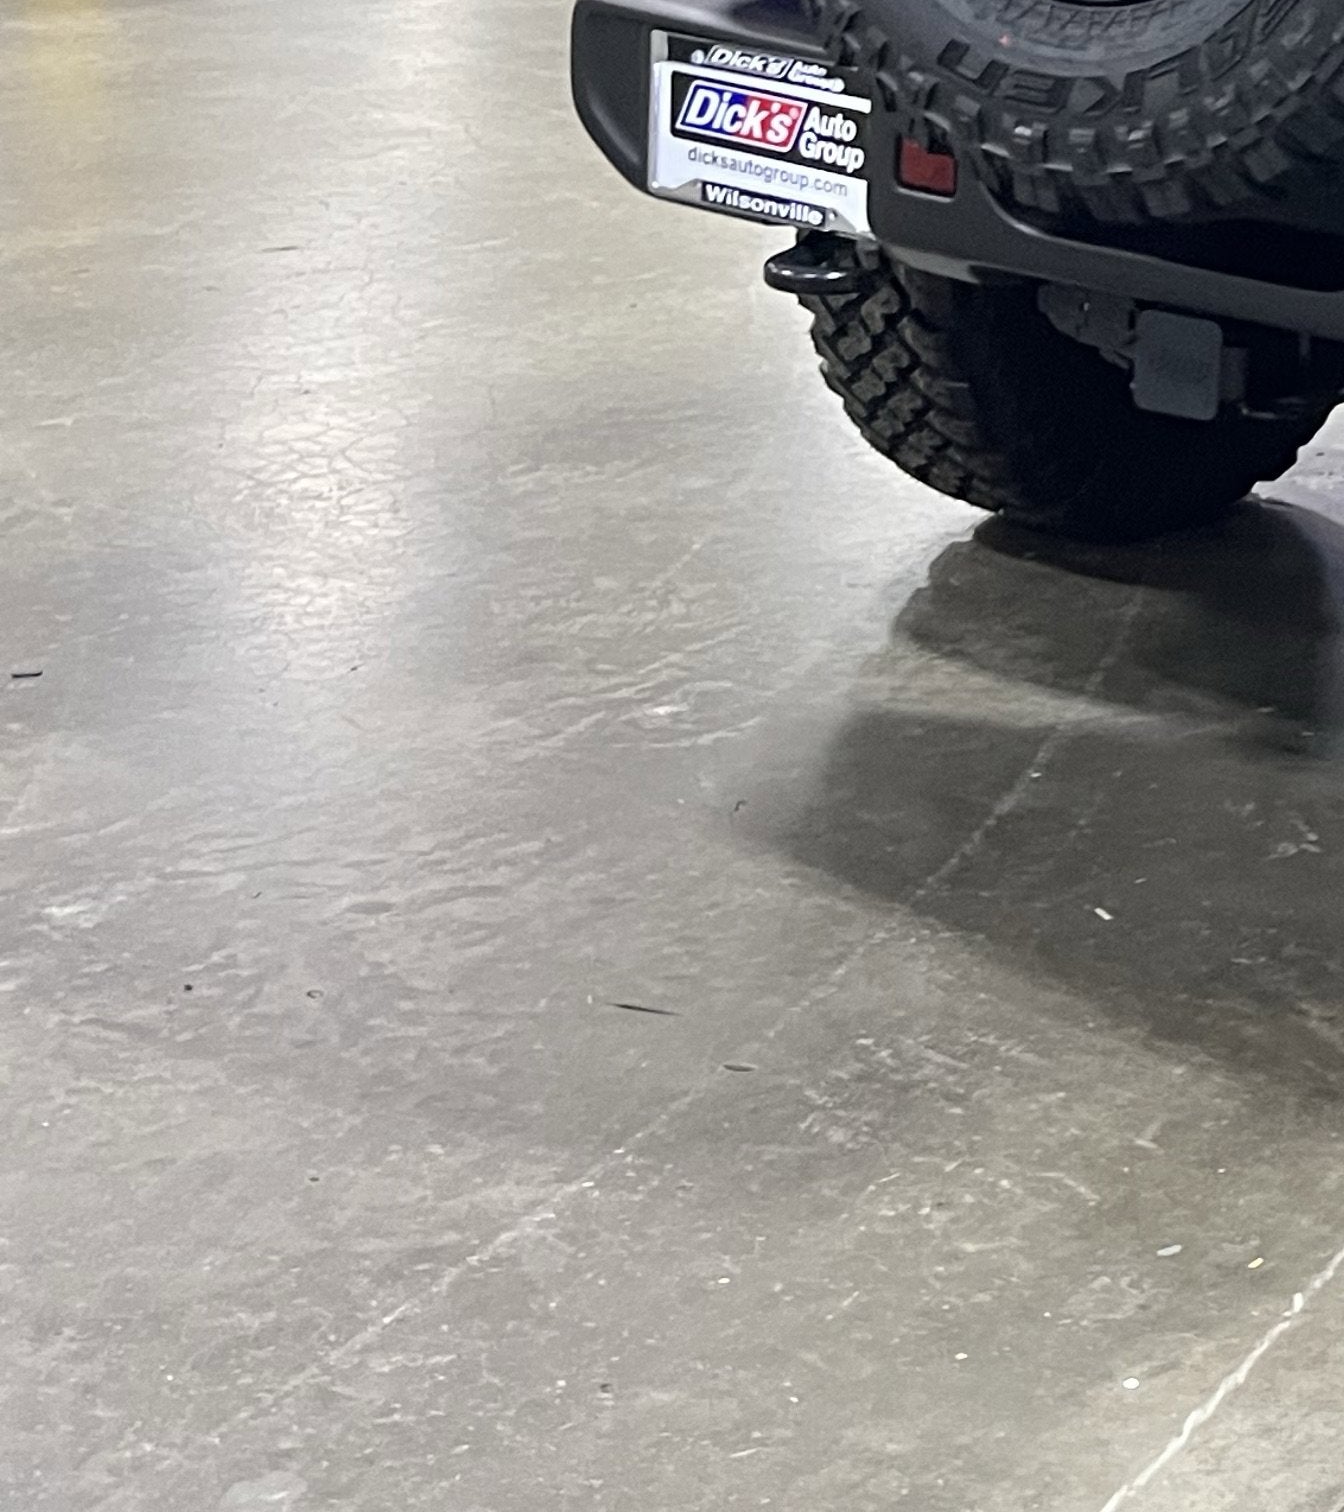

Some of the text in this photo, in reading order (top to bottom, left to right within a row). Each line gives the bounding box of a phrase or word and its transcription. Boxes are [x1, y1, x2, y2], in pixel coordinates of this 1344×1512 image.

[685, 88, 795, 144] Dick's
[803, 106, 857, 142] Auto
[688, 147, 848, 197] dicksautogroup.com
[799, 131, 865, 173] Group
[704, 184, 823, 226] Wilsonville
